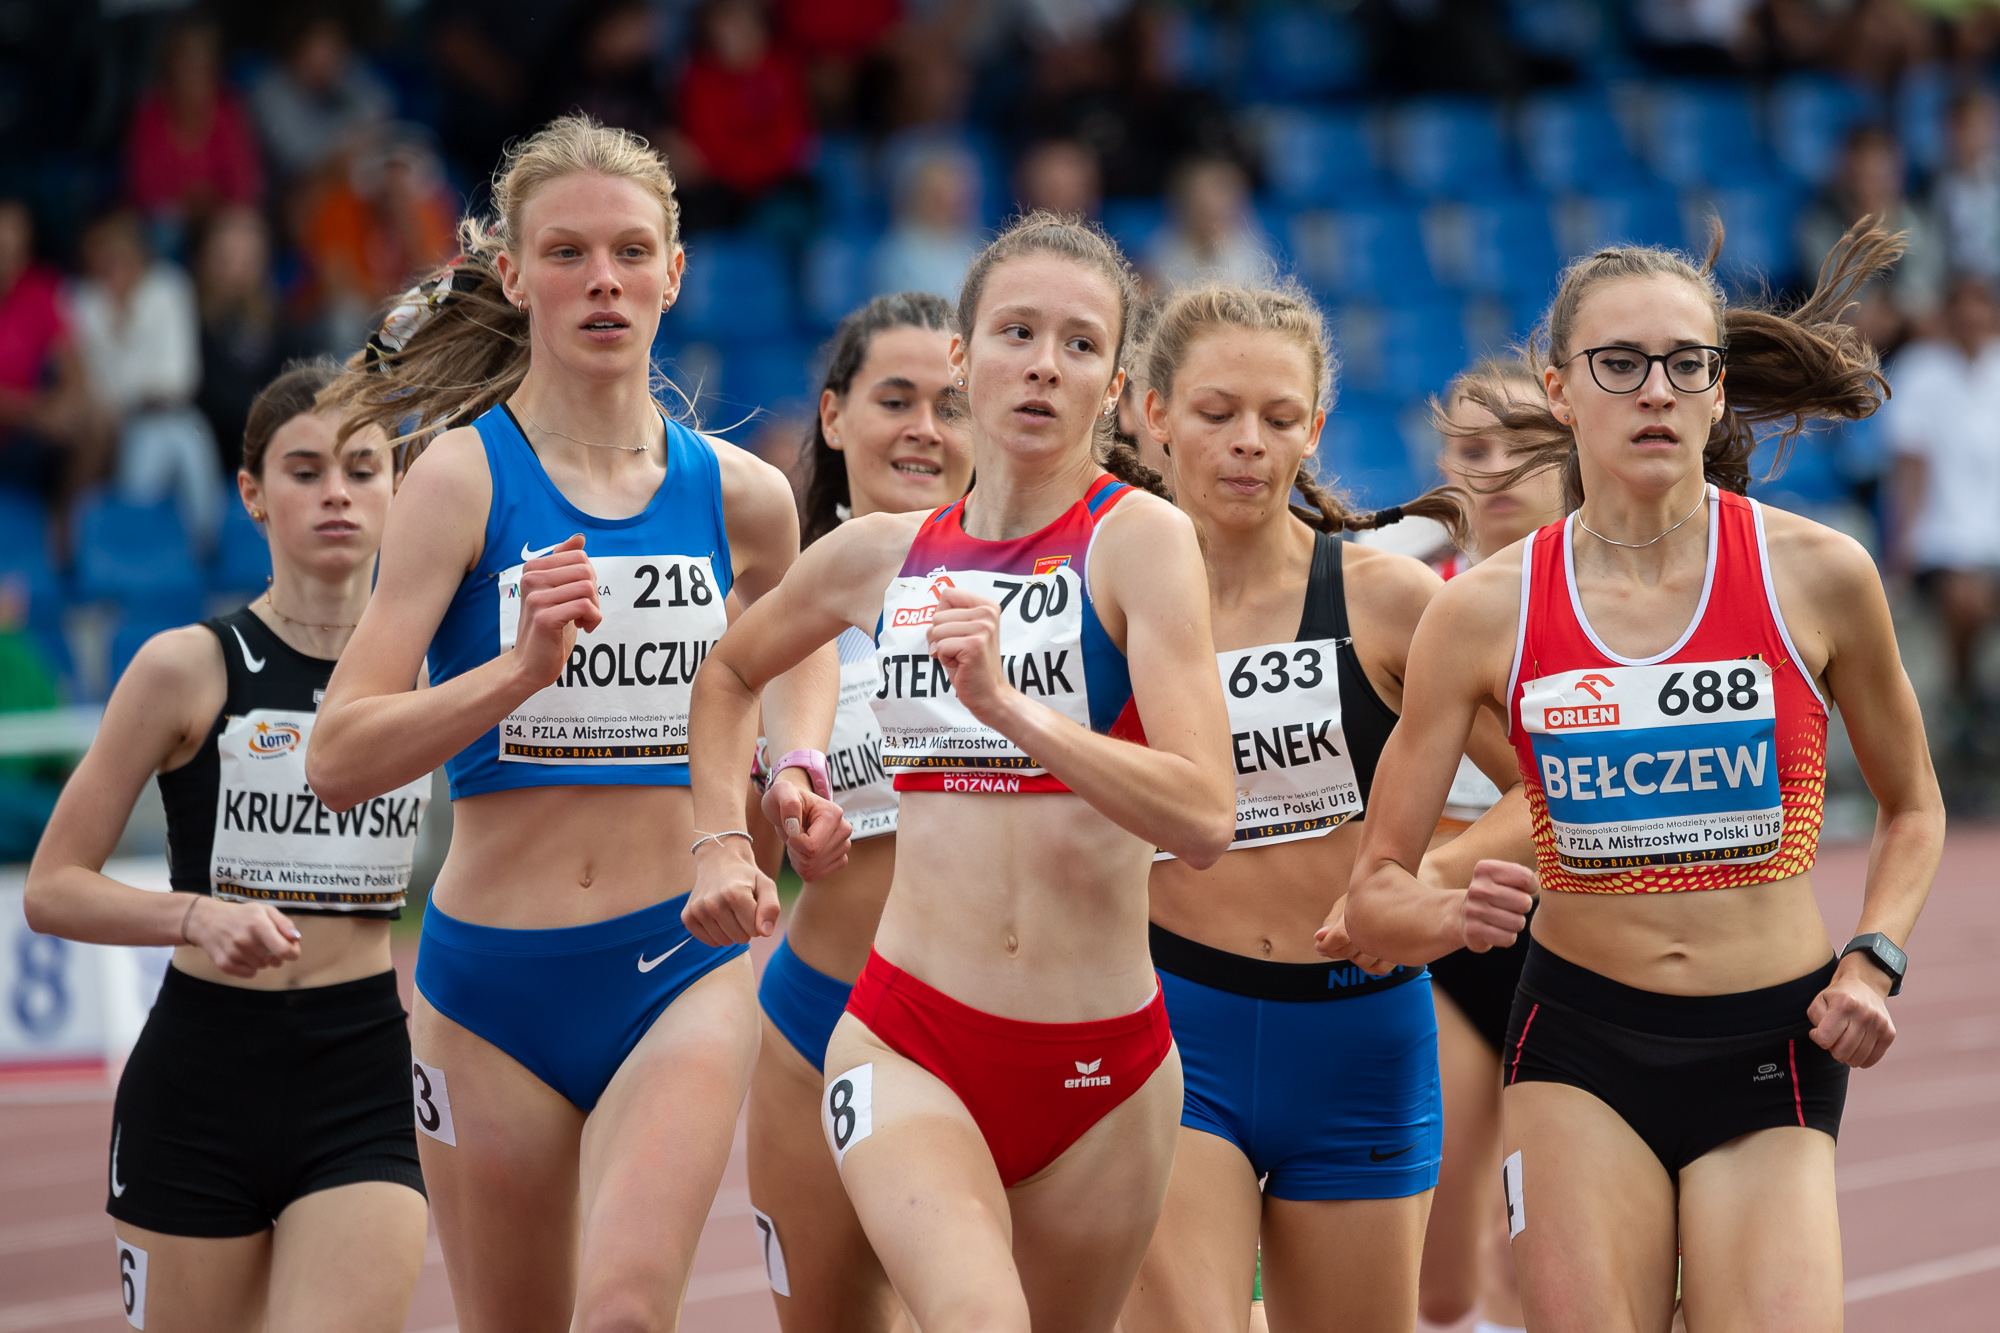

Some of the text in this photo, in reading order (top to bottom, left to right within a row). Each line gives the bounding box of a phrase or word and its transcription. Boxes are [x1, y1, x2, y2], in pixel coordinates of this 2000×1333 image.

[1038, 559, 1067, 567] ENERGETYK
[633, 563, 713, 609] 218
[993, 575, 1068, 624] 700
[895, 609, 934, 626] ORLE
[512, 639, 719, 689] ROLCZU
[876, 650, 1075, 700] STEMIAK
[1228, 648, 1323, 699] 633
[1658, 667, 1759, 717] 688
[528, 715, 585, 724] Ogólnopolska
[587, 715, 628, 724] Olimpiada
[629, 714, 667, 723] Młodzieży
[676, 713, 689, 721] lekk
[1547, 706, 1616, 728] ORLEN
[259, 733, 292, 750] LOTTO
[504, 723, 690, 740] 54. PZLA Mistrzostwa Pols
[897, 726, 939, 736] Ogólnopolska
[939, 725, 978, 734] Olimpiada
[509, 744, 613, 758] BIELSKO-BIAŁA
[637, 745, 689, 757] 15-17.07
[902, 736, 927, 750] PZLA
[928, 736, 1008, 750] Mistrzostwa
[1231, 719, 1342, 776] ENEK
[883, 756, 965, 767] BIELSKO-BIAŁA
[987, 758, 1038, 768] 15-17.0
[1541, 740, 1768, 801] BEŁCZEW
[943, 776, 1021, 793] POZNAŃ
[1248, 793, 1286, 805] Młodzieży
[1294, 789, 1320, 800] lekkiej
[1320, 781, 1354, 794] atletyce
[223, 783, 421, 840] KRUŻEWSKA
[1283, 797, 1325, 816] Polski
[1328, 790, 1358, 808] U18
[1259, 813, 1348, 837] 15-17.07.202
[1565, 826, 1619, 836] Ogólnopolska
[1620, 823, 1664, 834] Olimpiada
[1666, 818, 1708, 829] Młodzieży
[1718, 814, 1746, 824] lekkiej
[1746, 811, 1781, 822] atletyce
[1569, 837, 1604, 851] PZLA
[1608, 831, 1699, 850] Mistrzostwa
[1703, 824, 1749, 842] Polski
[1753, 820, 1781, 837] U18
[1558, 854, 1652, 869] BIELSKO-BIAŁA
[1677, 841, 1777, 863] 15-17.07.2022
[215, 866, 237, 880] 54.
[240, 868, 275, 883] PZLA
[278, 870, 361, 887] Mistrzostwa
[364, 873, 396, 887] Polski
[220, 883, 317, 902] BIELSKO-BIAŁA
[1064, 1075, 1111, 1089] erima
[413, 1062, 441, 1132] 3
[829, 1078, 856, 1151] 8
[120, 1248, 137, 1317] 6
